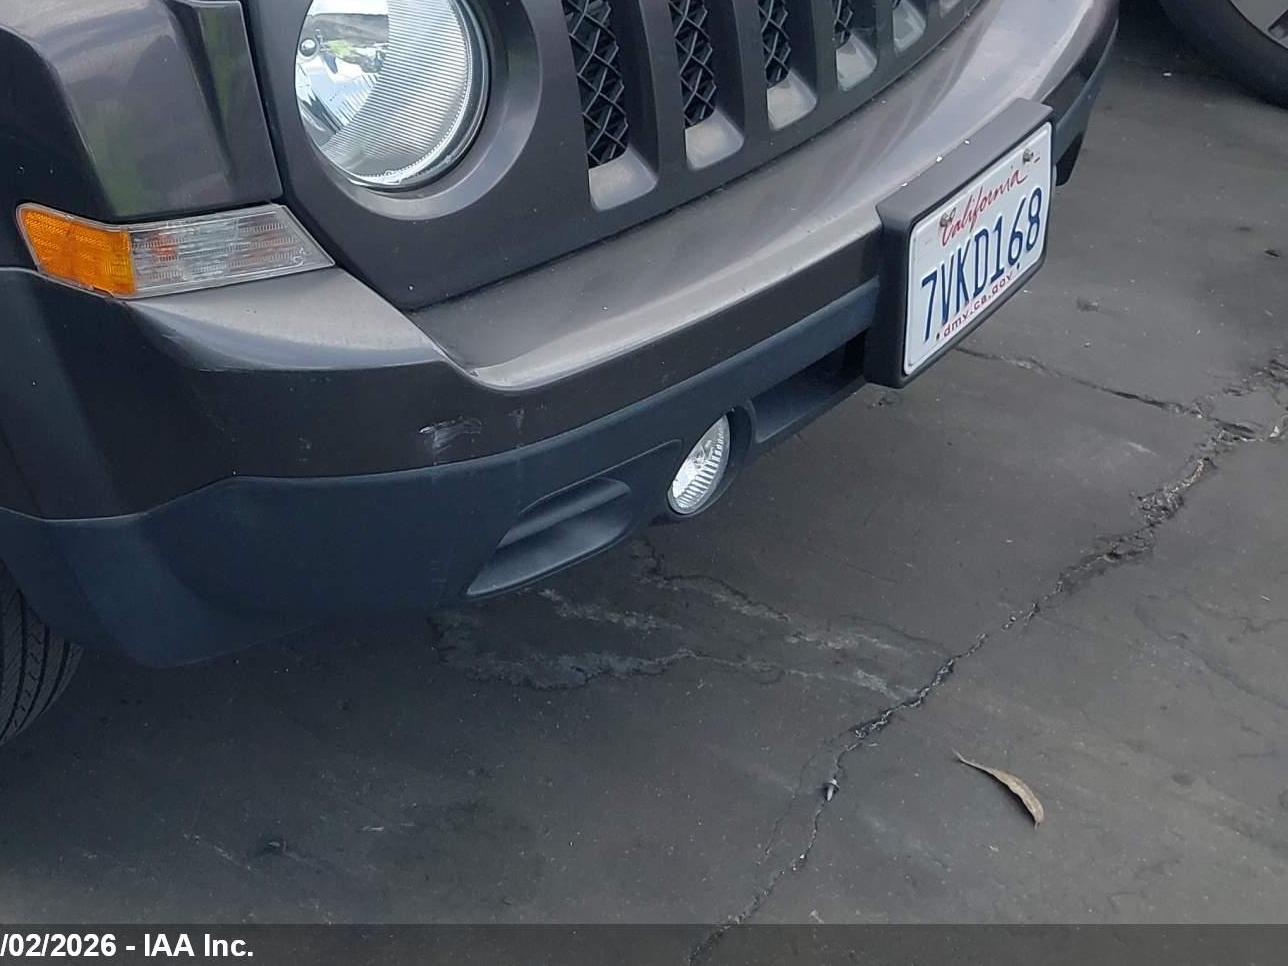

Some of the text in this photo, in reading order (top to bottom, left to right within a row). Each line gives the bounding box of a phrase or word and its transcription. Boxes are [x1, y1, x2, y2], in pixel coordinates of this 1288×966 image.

[939, 169, 1028, 247] California
[921, 186, 1043, 343] 7VKD168
[943, 270, 1014, 338] dmv.ca.gov
